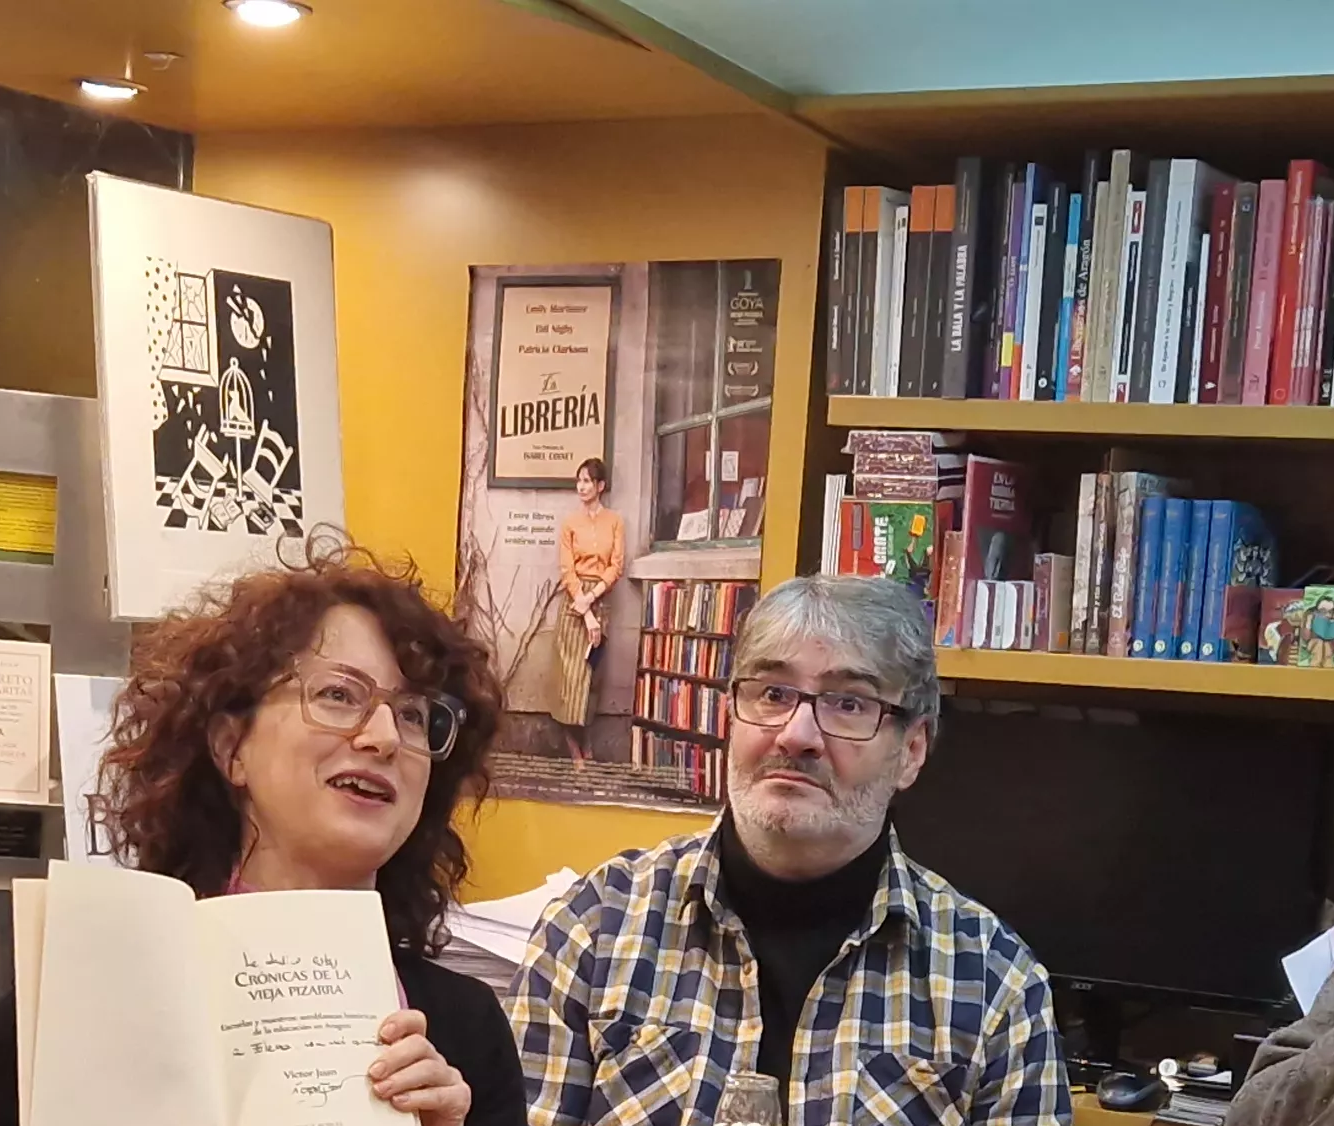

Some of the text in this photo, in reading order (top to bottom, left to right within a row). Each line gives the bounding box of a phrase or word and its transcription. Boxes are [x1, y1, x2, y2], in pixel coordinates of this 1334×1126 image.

[956, 244, 968, 287] PALABRA
[1075, 239, 1091, 298] de Aragón
[954, 289, 966, 301] LA
[730, 298, 764, 310] GOYA
[951, 339, 962, 352] LA
[501, 385, 600, 438] LIBRERÍA
[235, 969, 351, 987] CRÓNICAS DE LA
[248, 985, 343, 1001] VIEJA PIZARRA
